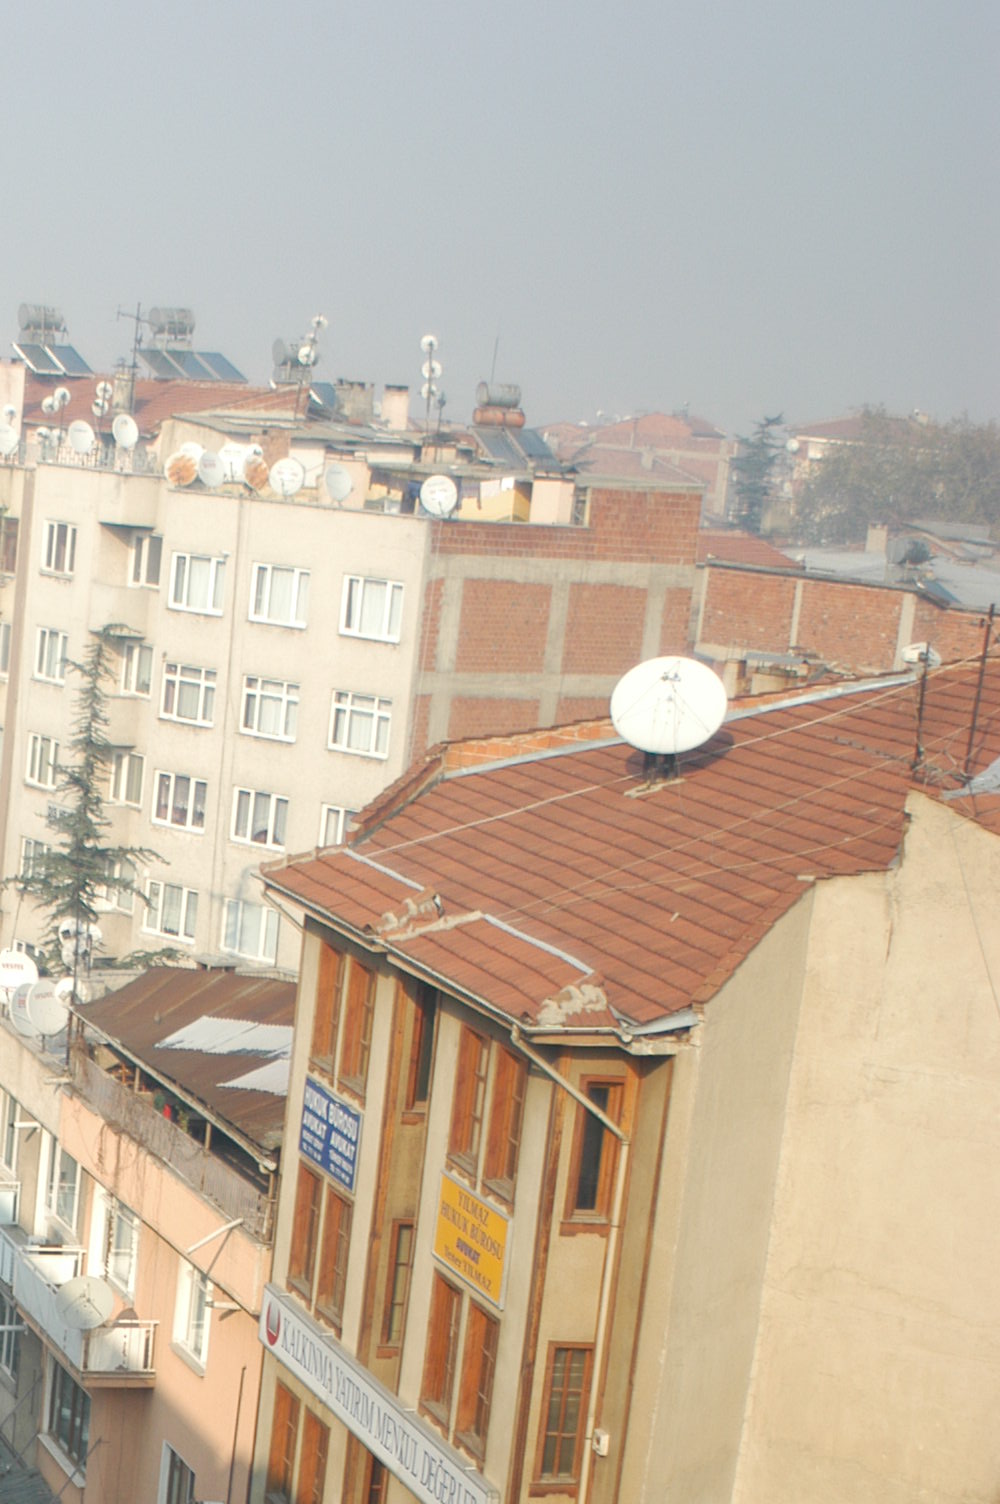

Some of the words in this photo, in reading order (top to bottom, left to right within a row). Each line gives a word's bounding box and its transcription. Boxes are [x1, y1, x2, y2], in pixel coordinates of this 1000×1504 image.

[328, 1101, 358, 1142] BÜROSU
[458, 1191, 490, 1227] YILMAZ
[440, 1201, 469, 1236] HUKUK
[469, 1222, 505, 1261] BÜROSU
[456, 1237, 480, 1265] AVUKAT
[282, 1317, 333, 1395] KALKINMA
[334, 1365, 375, 1434] YATIRIM
[373, 1406, 419, 1478] MENKUL
